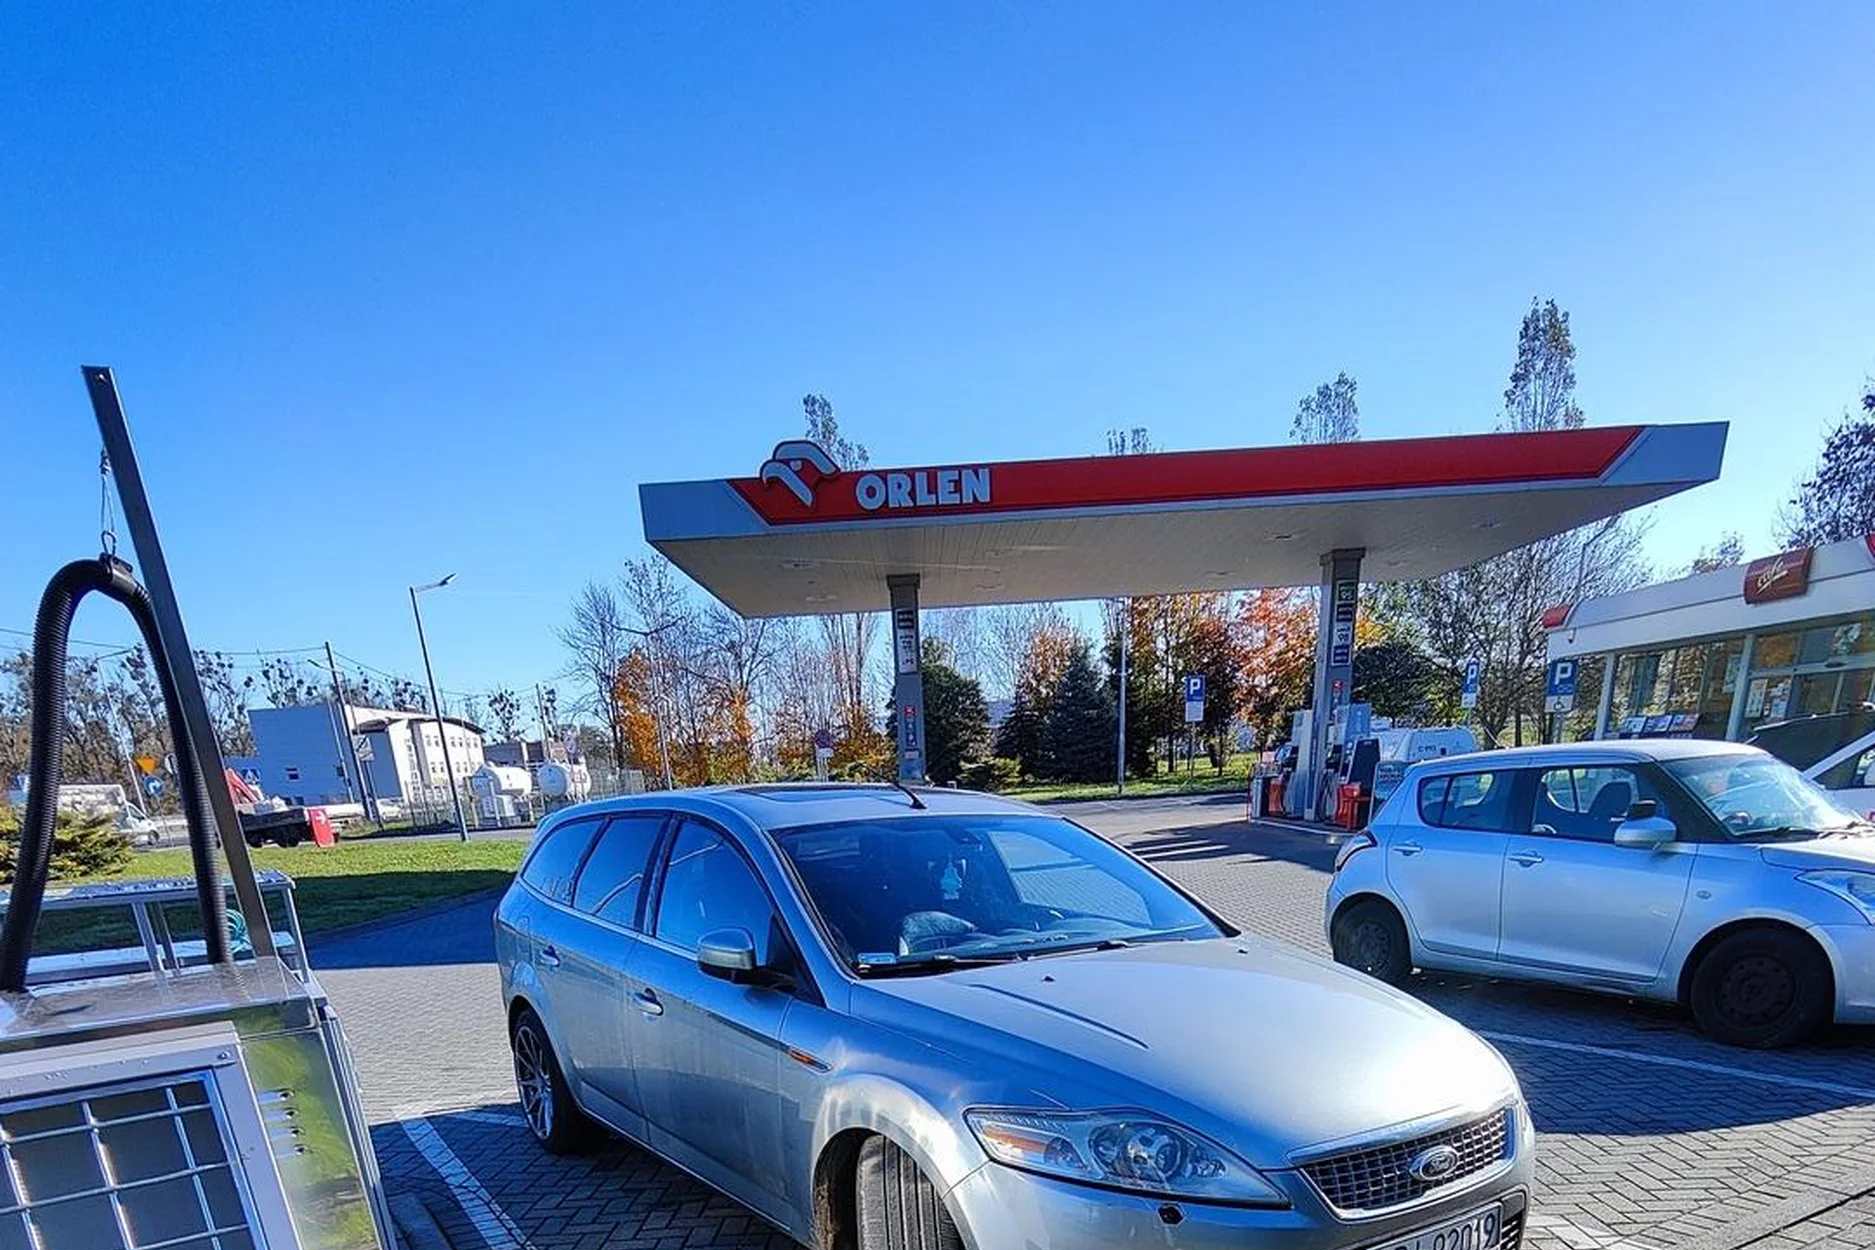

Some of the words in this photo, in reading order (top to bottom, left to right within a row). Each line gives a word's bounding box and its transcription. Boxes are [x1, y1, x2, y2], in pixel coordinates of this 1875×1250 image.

[855, 468, 991, 510] ORLEN
[1467, 664, 1477, 684] P
[1554, 662, 1573, 685] P
[1189, 678, 1201, 695] P
